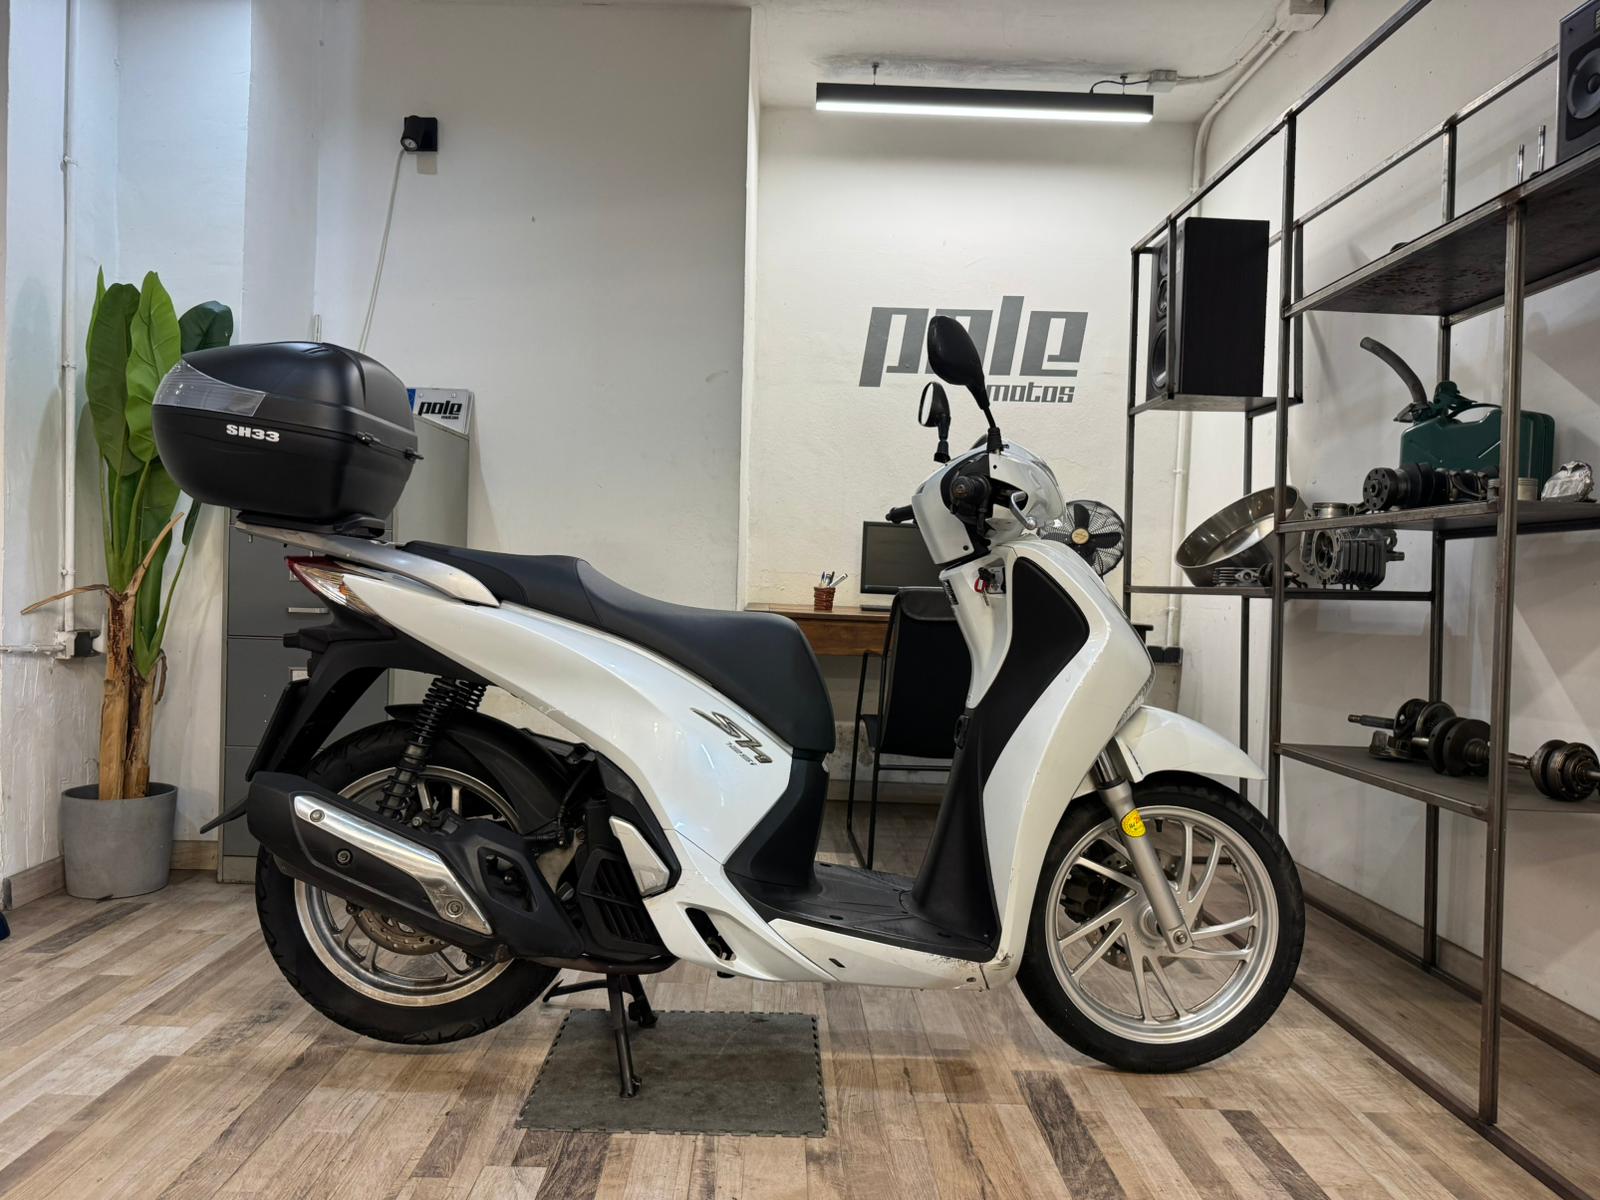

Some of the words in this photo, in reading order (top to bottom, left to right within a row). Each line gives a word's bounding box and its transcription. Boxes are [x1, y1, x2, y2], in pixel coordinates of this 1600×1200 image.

[987, 382, 1075, 403] motos
[418, 400, 463, 416] pole
[226, 424, 280, 442] SH33
